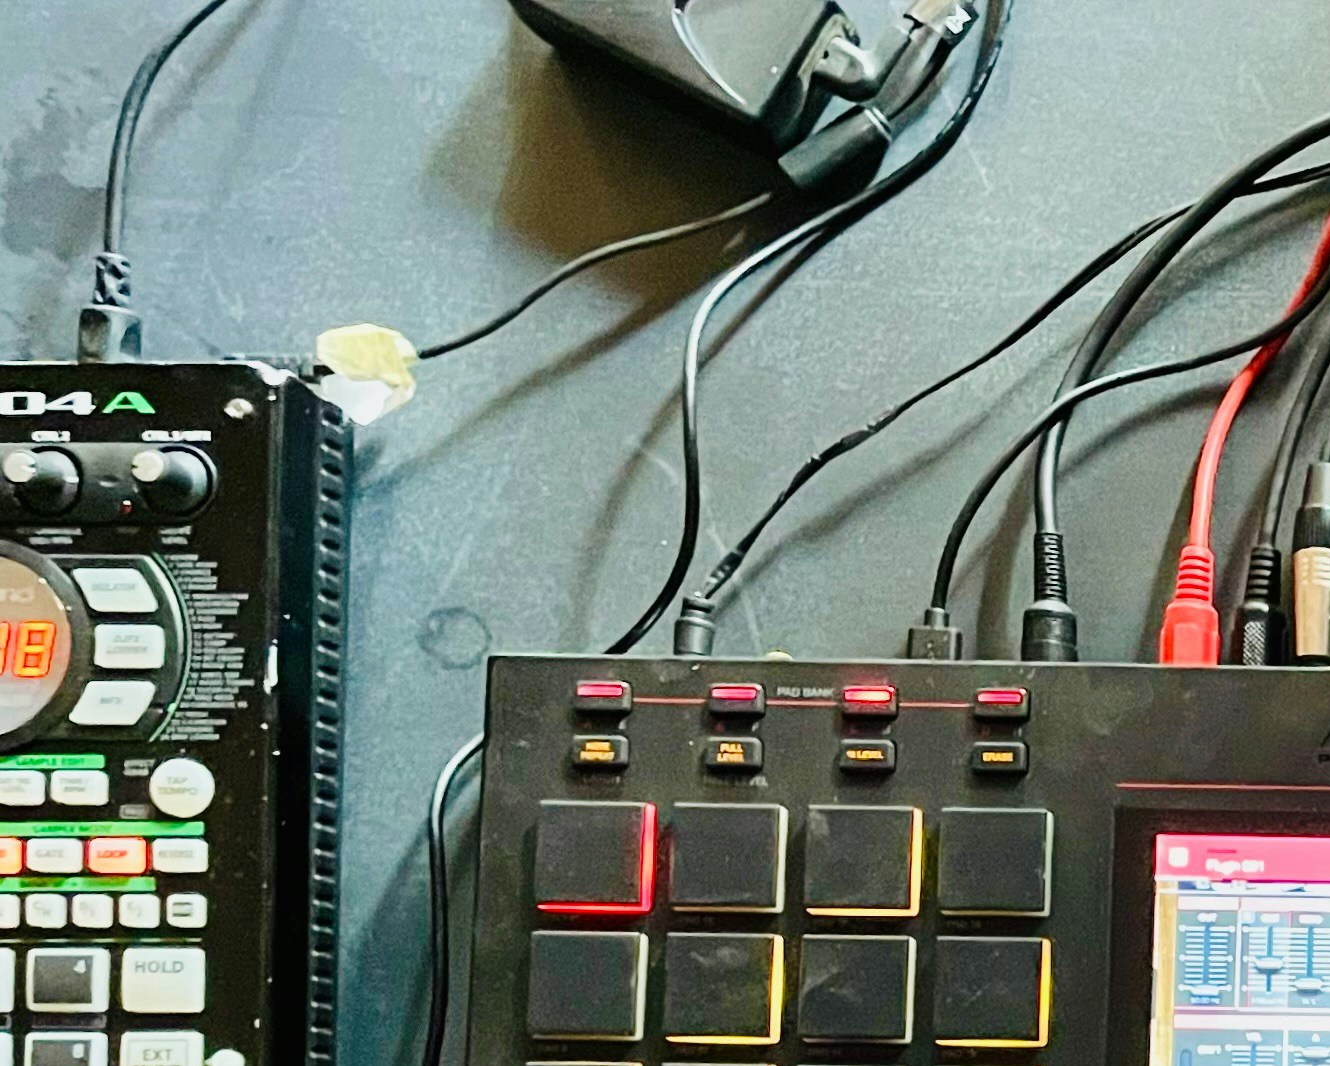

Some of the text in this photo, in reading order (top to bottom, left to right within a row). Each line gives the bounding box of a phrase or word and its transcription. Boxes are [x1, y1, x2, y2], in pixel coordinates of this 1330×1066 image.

[97, 849, 129, 859] LOOP
[73, 959, 87, 974] 4
[134, 960, 185, 974] HOLD
[142, 1048, 173, 1061] EXT
